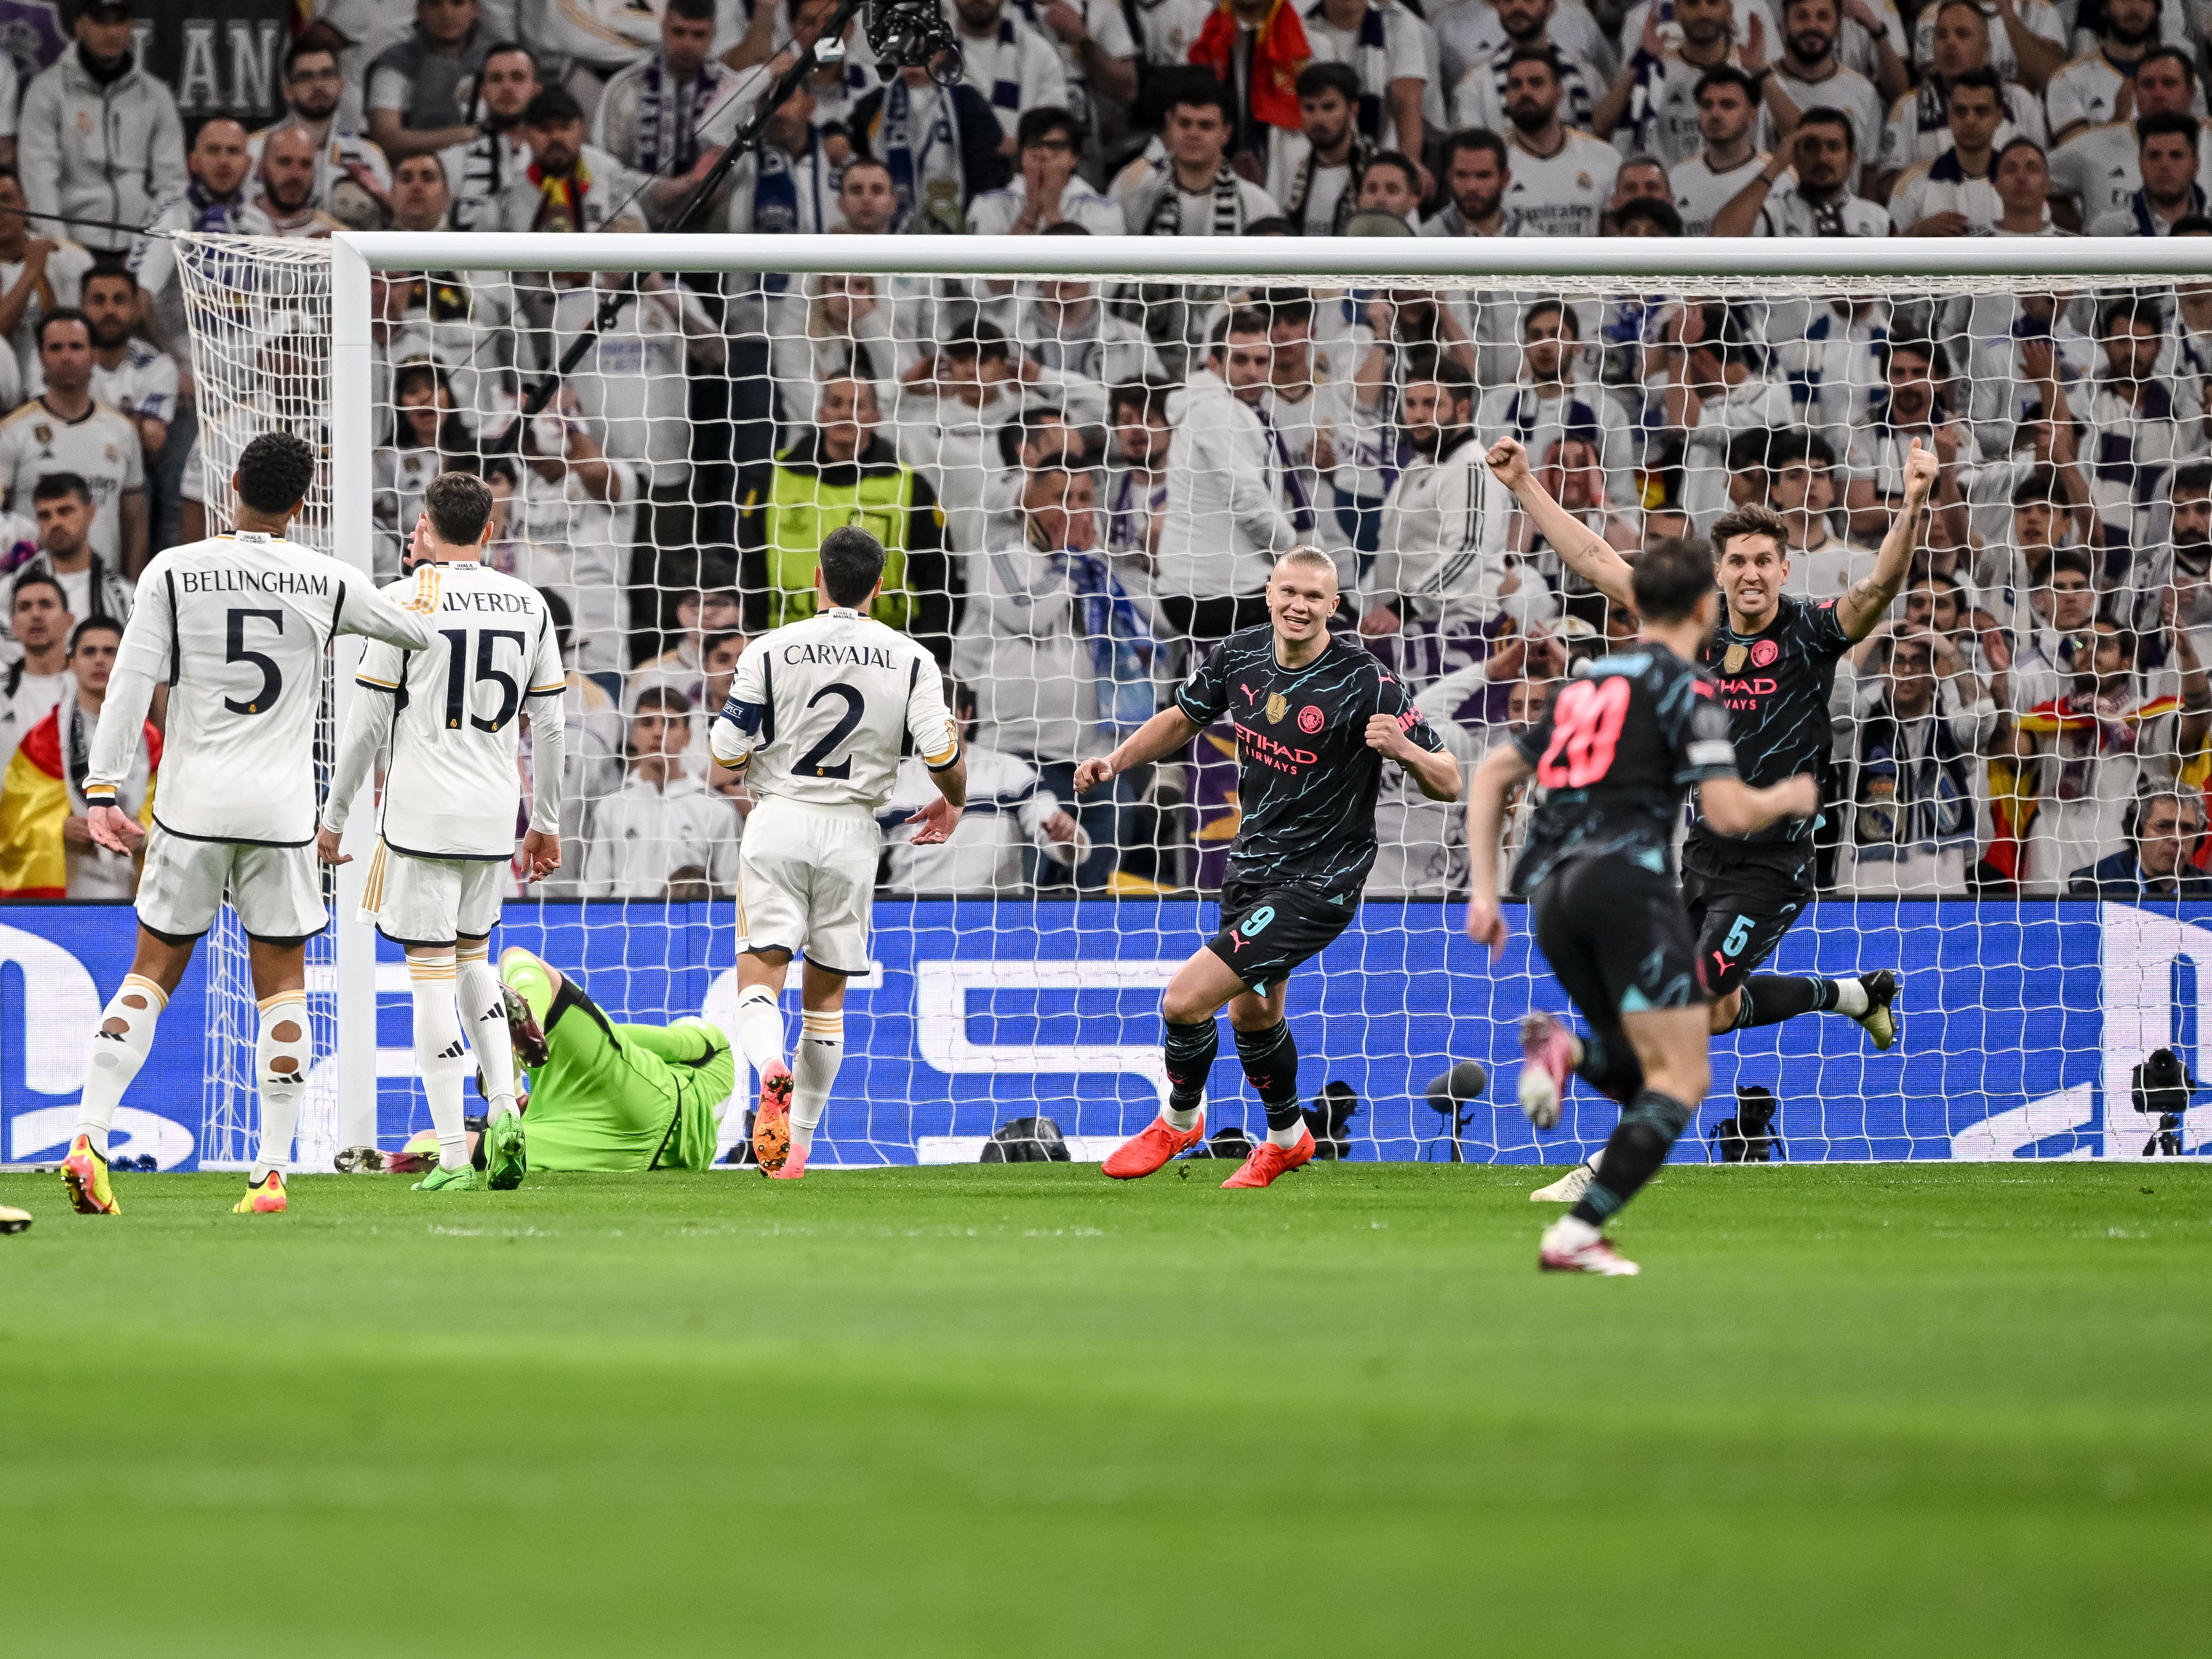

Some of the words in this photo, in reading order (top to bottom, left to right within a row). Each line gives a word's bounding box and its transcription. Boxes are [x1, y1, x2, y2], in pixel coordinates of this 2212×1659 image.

[182, 569, 327, 596] BELLINGHAM
[442, 592, 535, 615] LVERDE
[224, 608, 283, 715] 5
[784, 644, 897, 670] CARVAJAL
[438, 629, 525, 733] 15
[790, 682, 865, 780] 2
[1234, 721, 1318, 764] ETIHAD
[1538, 675, 1631, 789] 20
[1241, 906, 1275, 937] 9
[1722, 914, 1756, 957] 5
